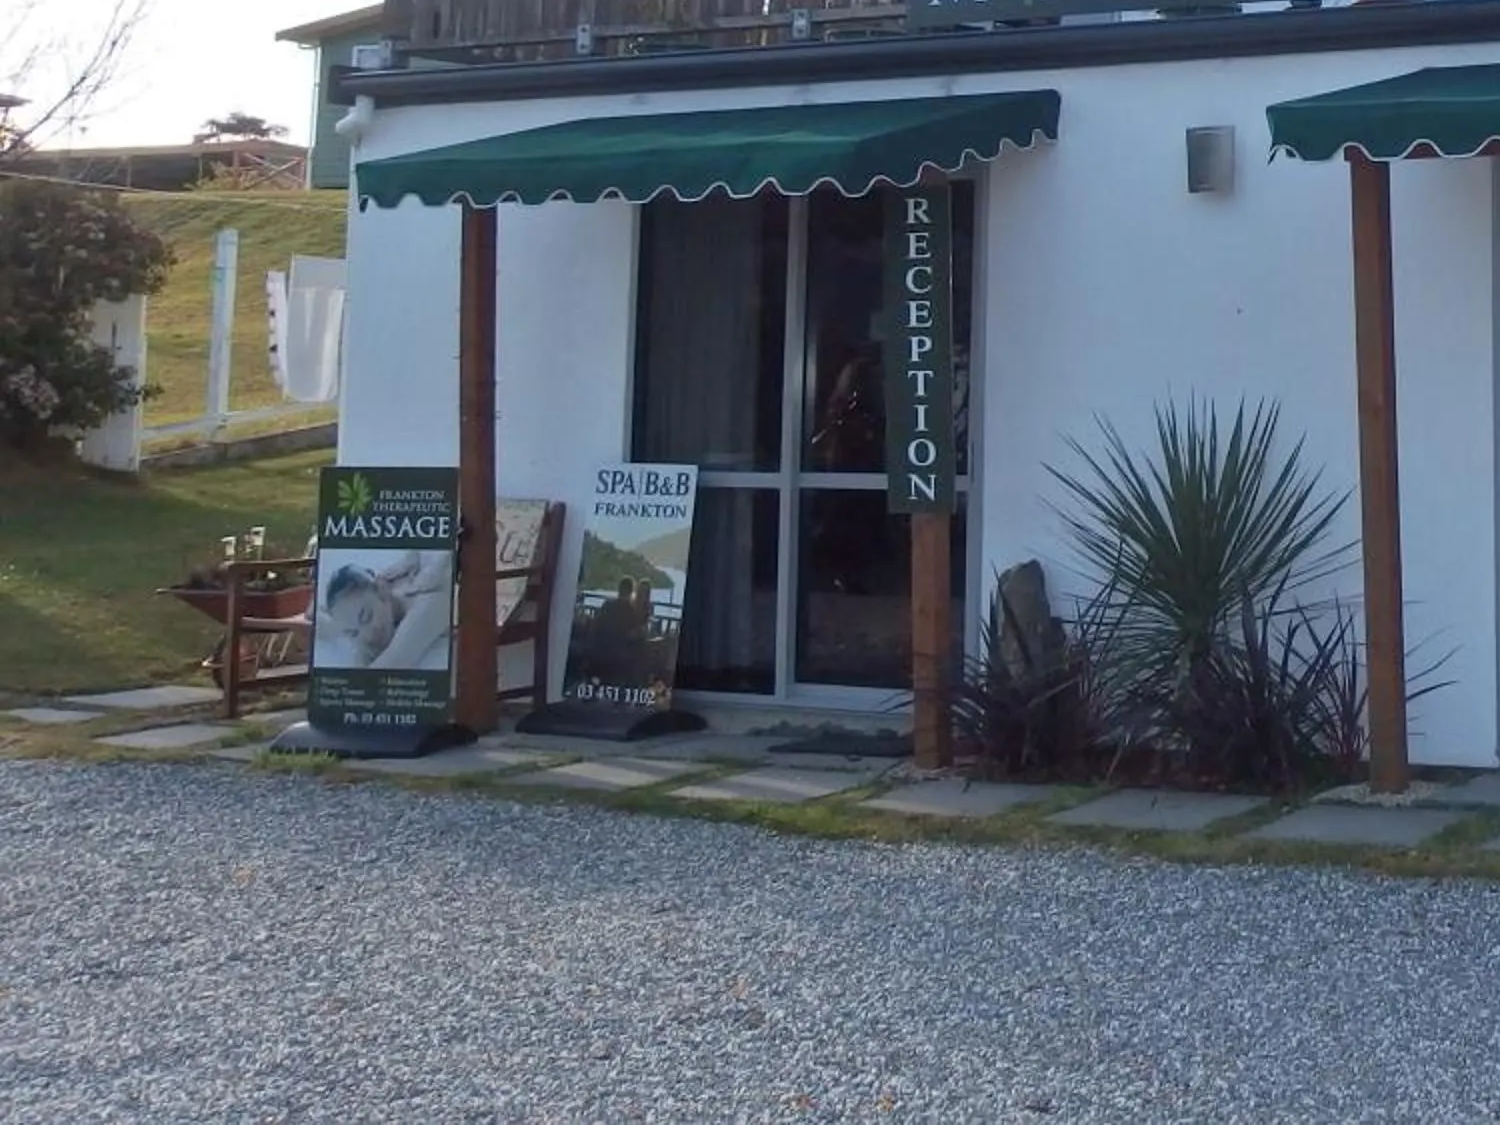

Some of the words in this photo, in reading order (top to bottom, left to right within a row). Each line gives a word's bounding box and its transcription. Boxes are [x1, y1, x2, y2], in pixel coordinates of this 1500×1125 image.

[904, 197, 937, 502] RECEPTION
[595, 470, 636, 495] SPA
[644, 471, 690, 496] B&B
[379, 490, 445, 500] FRANKTON
[373, 501, 451, 512] THERAPEUTIC
[594, 502, 687, 518] FRANKTON
[325, 515, 451, 538] MASSAGE
